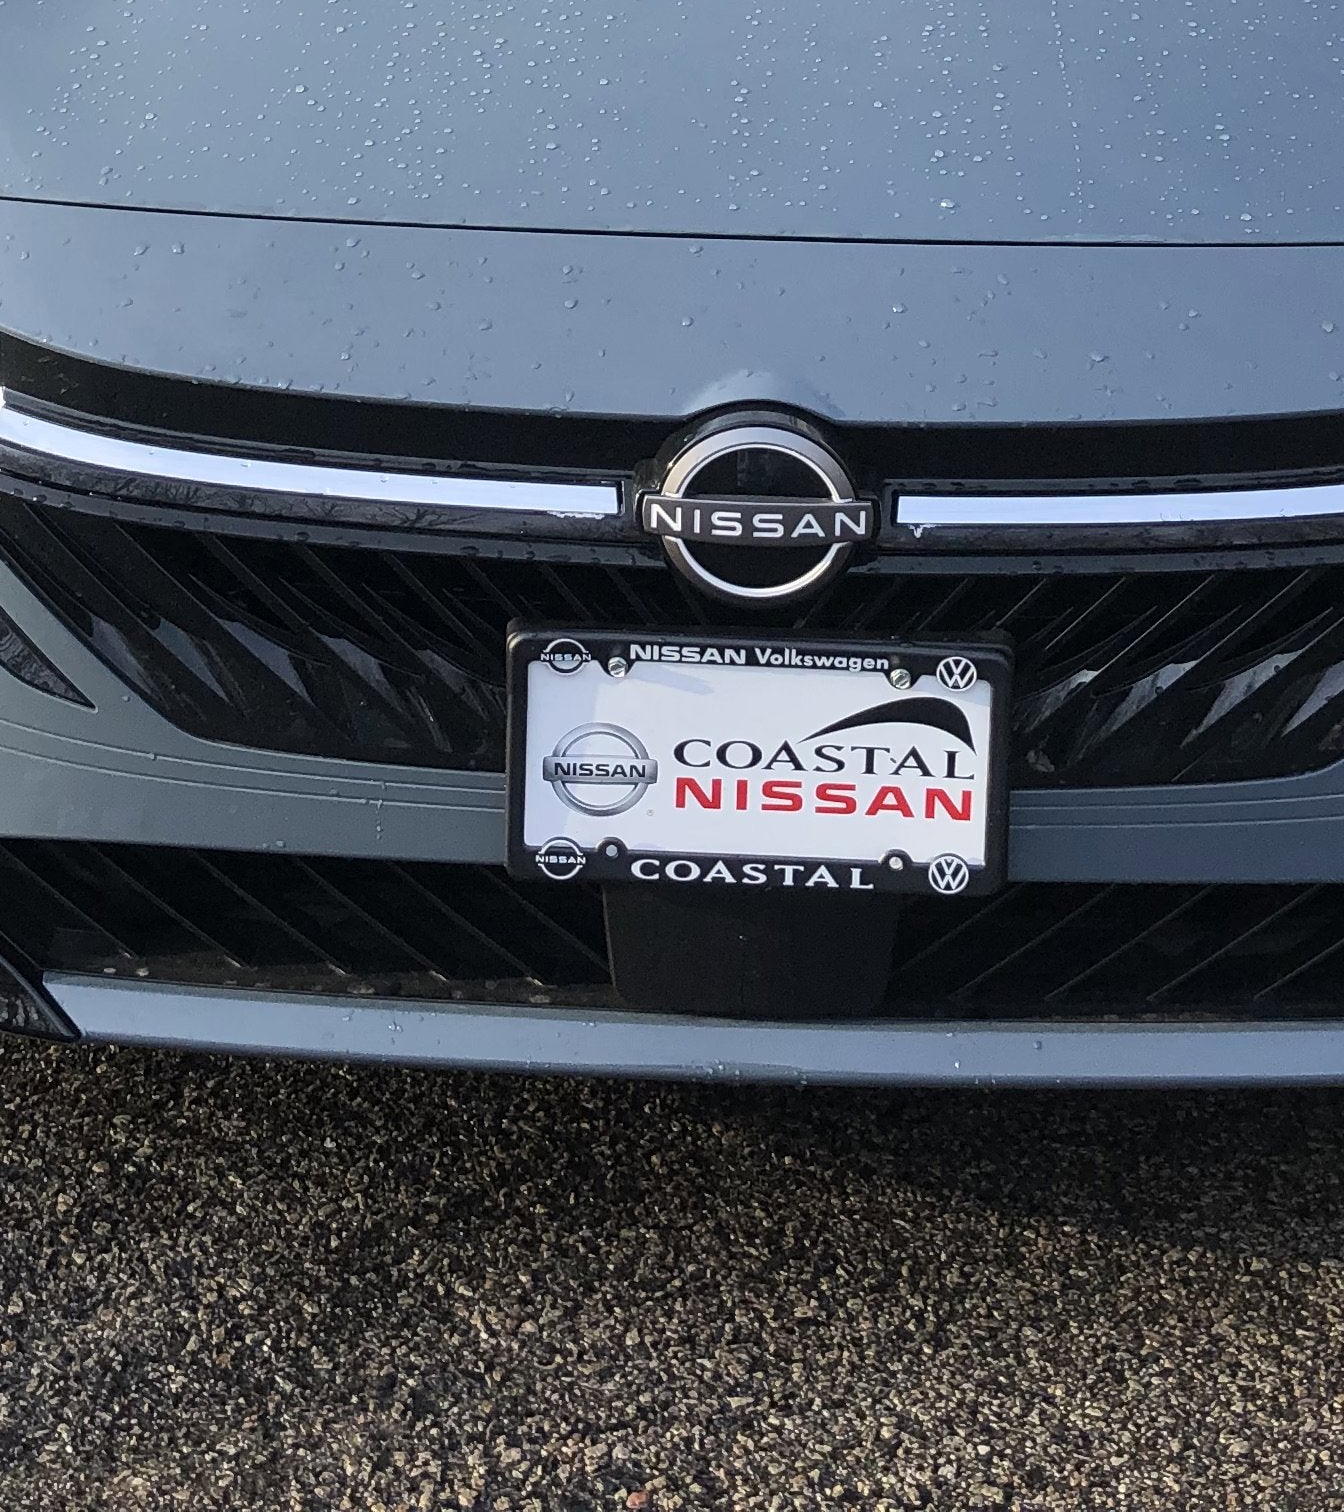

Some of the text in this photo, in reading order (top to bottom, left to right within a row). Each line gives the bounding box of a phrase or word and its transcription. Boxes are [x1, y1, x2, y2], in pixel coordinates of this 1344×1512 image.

[649, 504, 867, 538] NISSAN
[540, 650, 592, 663] NISSAN
[630, 643, 889, 671] NISSAN Volkswagen
[553, 762, 647, 779] NISSAN
[673, 738, 975, 780] COASTAL
[675, 777, 973, 821] NISSAN
[535, 853, 587, 866] NISSAN
[630, 859, 875, 890] COASTAL
